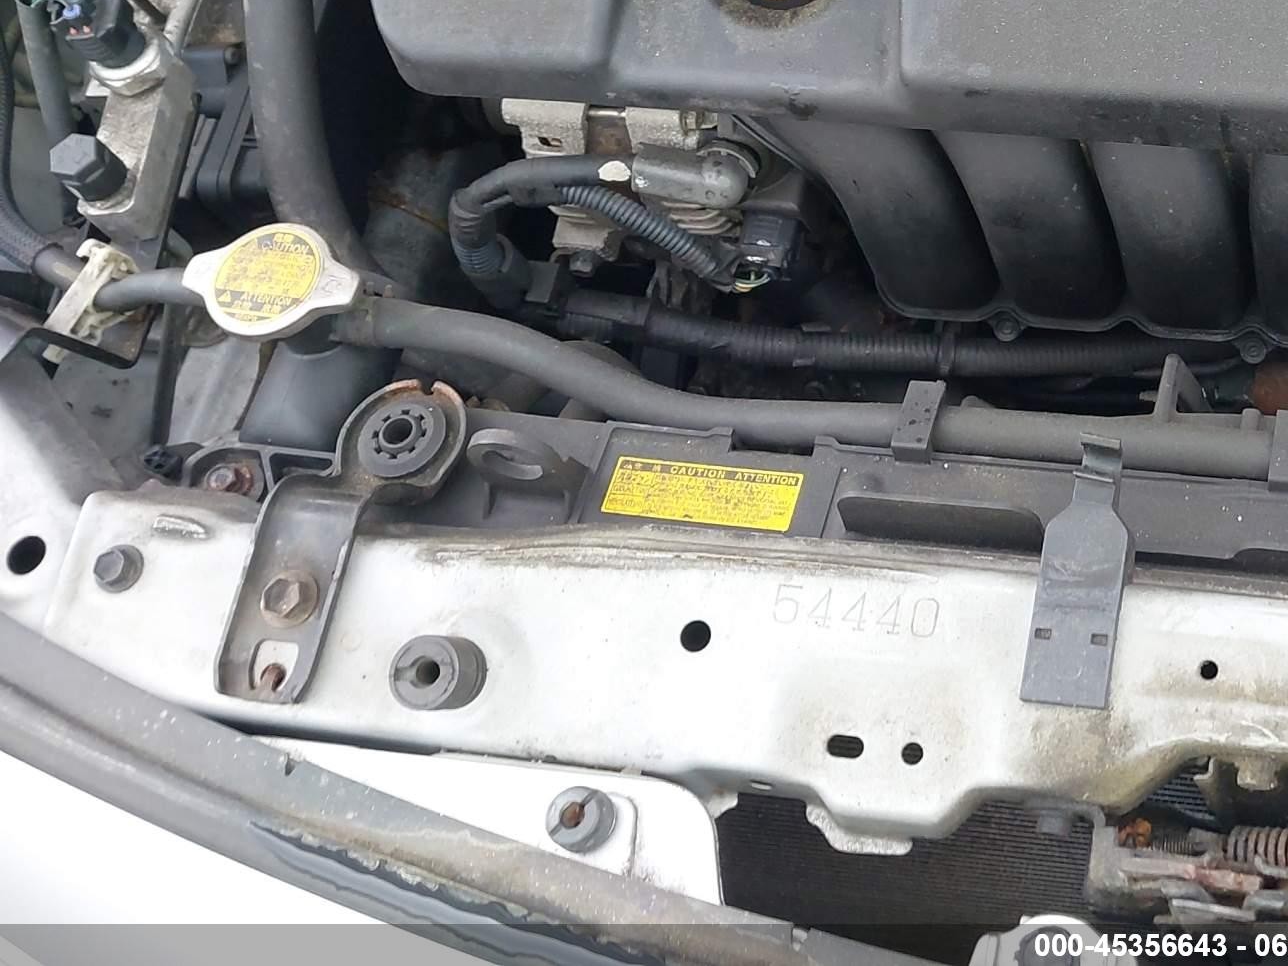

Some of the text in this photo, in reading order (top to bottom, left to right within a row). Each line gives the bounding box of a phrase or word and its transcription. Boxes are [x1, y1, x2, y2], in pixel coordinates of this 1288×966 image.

[262, 240, 310, 255] CAUTION
[239, 291, 293, 307] ATTENTION
[670, 462, 726, 479] CAUTION
[735, 472, 797, 486] ATTENTION
[773, 584, 940, 638] 54440
